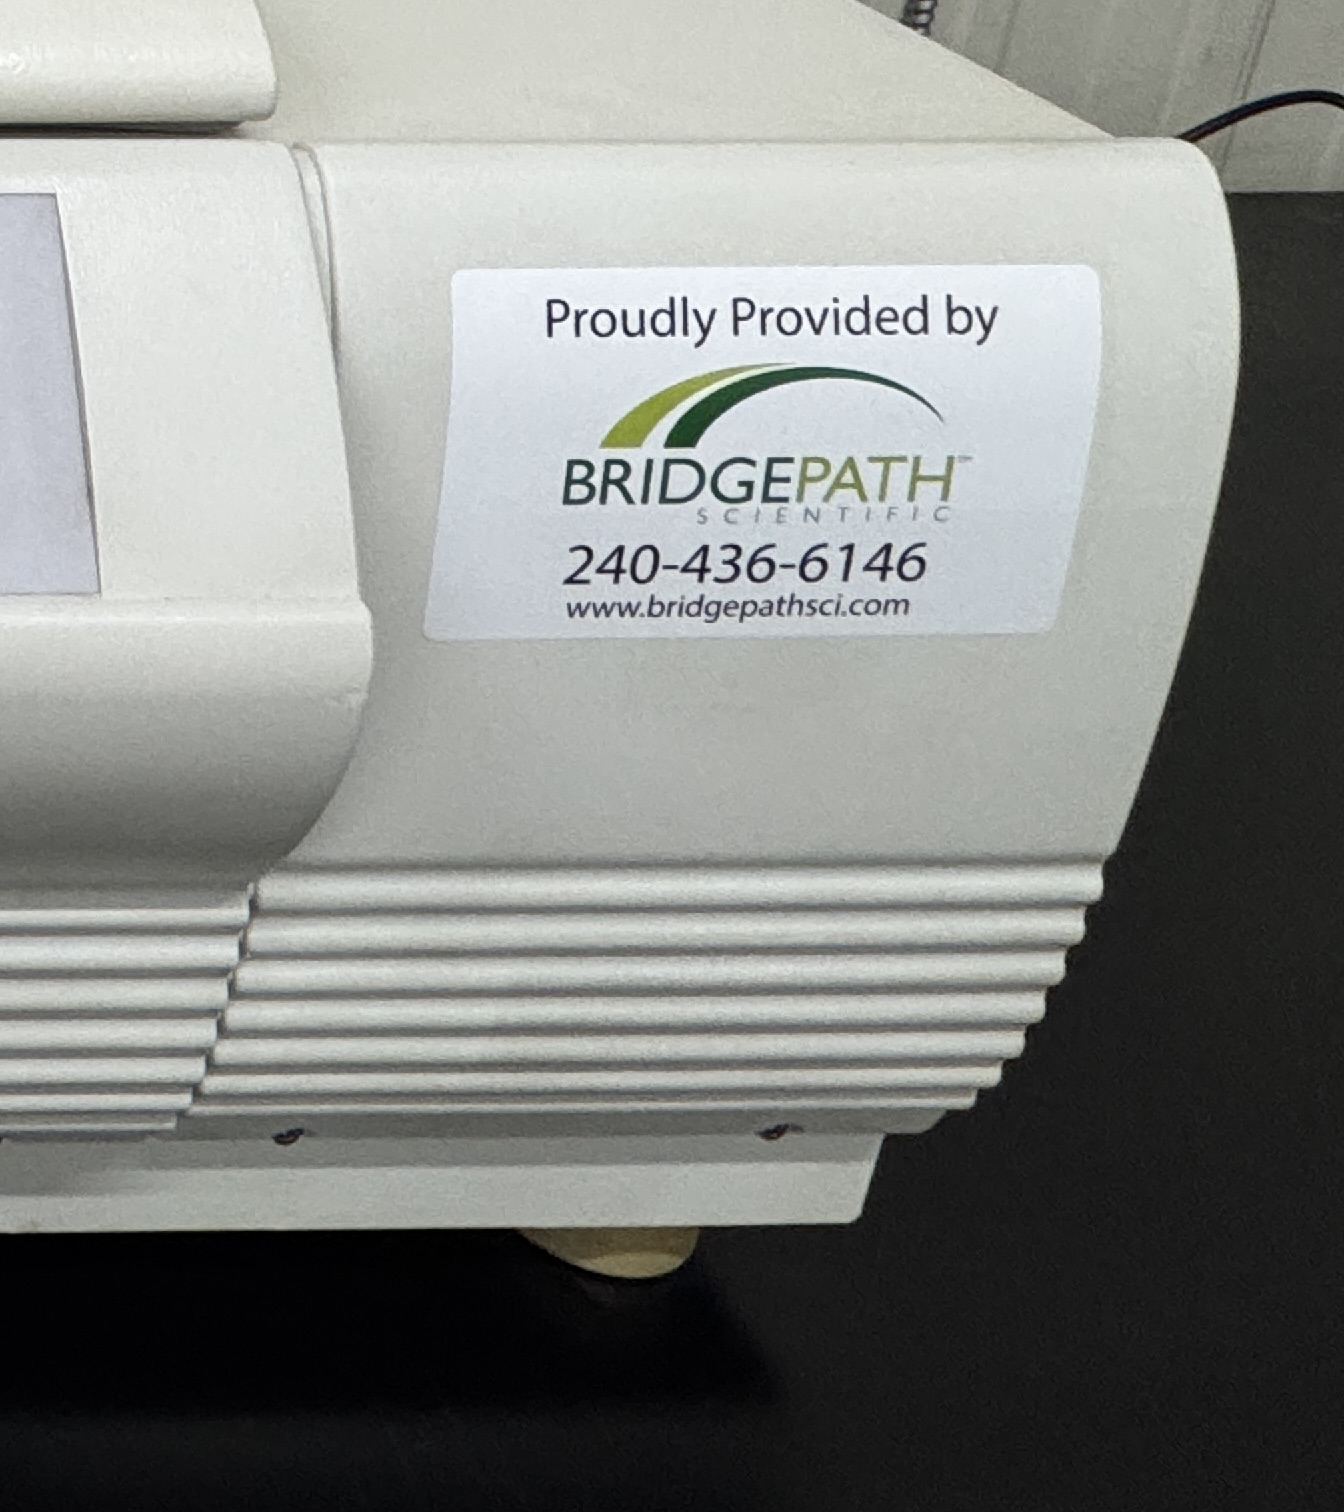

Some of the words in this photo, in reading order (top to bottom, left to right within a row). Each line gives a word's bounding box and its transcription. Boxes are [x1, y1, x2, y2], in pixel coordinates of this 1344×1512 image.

[545, 296, 718, 349] Proudly
[731, 294, 930, 337] Provided
[945, 294, 999, 346] by
[696, 505, 952, 525] SCIENTIFIC
[562, 541, 928, 586] 240-436-6146
[565, 592, 911, 625] www.bridgepathsci.com
